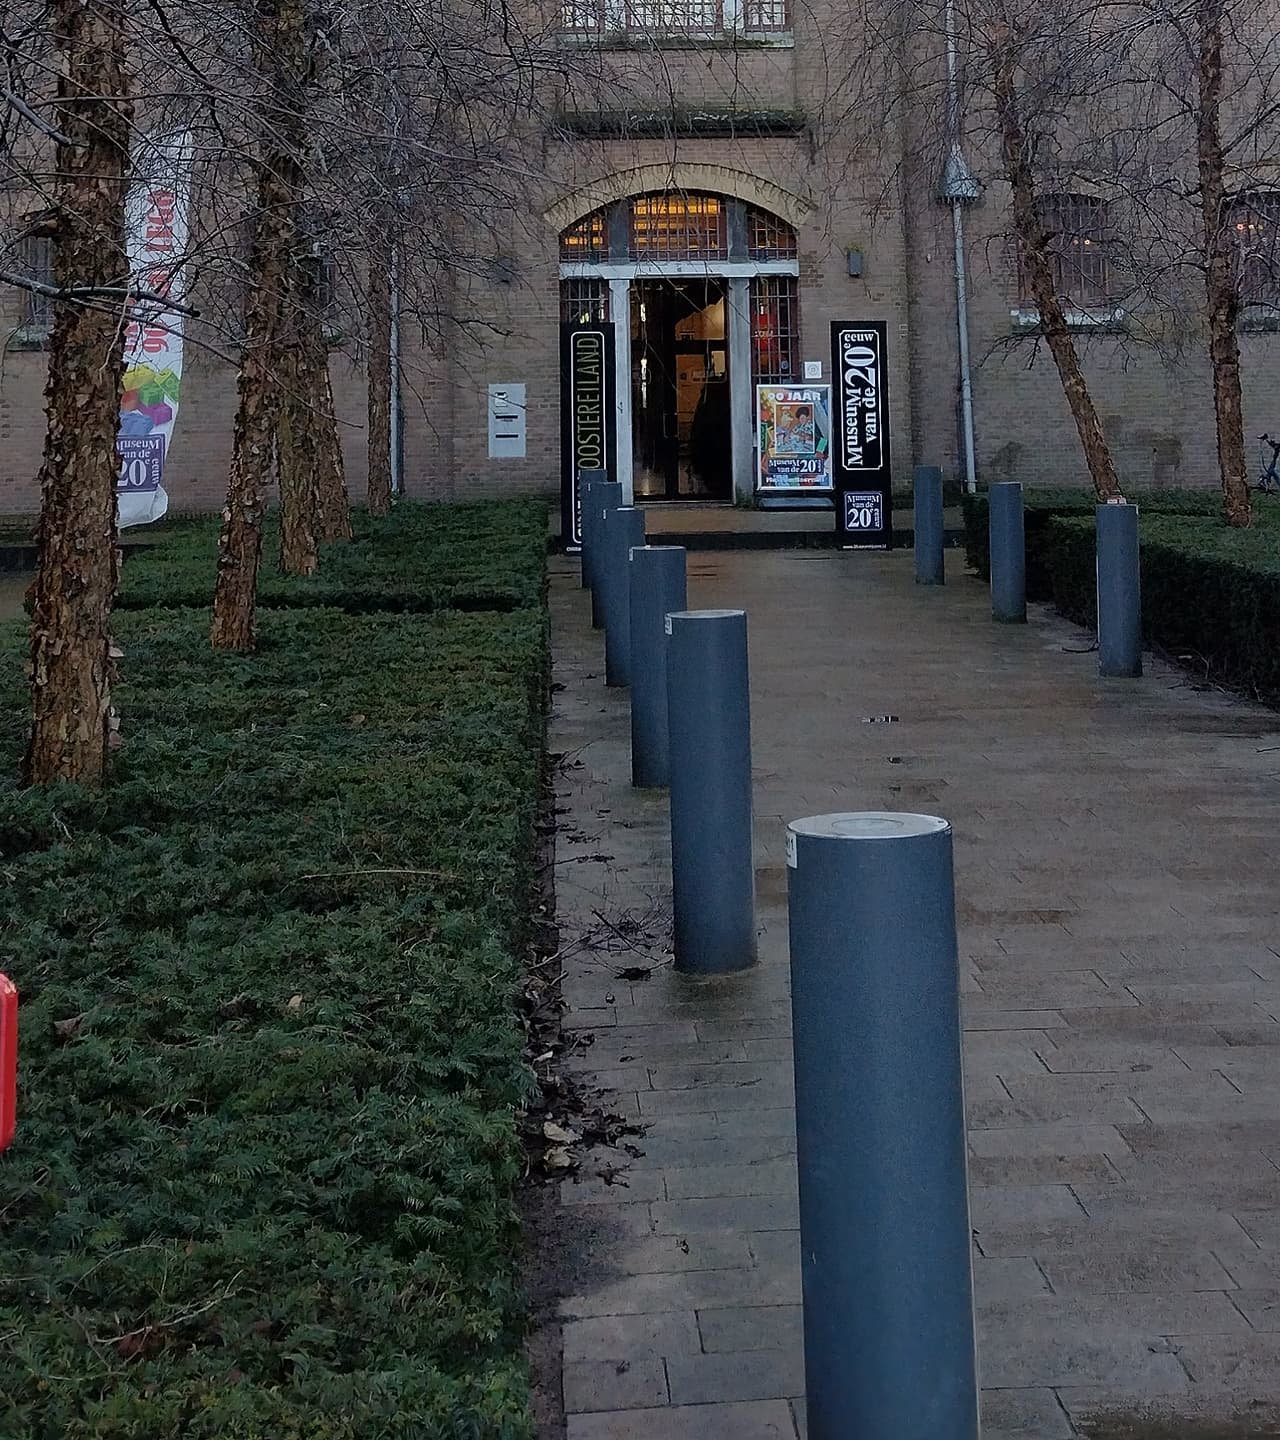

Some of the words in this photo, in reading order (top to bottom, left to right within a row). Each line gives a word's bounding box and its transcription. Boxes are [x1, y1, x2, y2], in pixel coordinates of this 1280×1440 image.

[844, 333, 874, 342] eeuw
[577, 337, 600, 468] OOSTEREILAND
[786, 391, 821, 400] JAAR
[862, 387, 876, 408] de
[866, 412, 877, 443] van
[138, 450, 150, 458] de
[151, 458, 160, 484] eeuw
